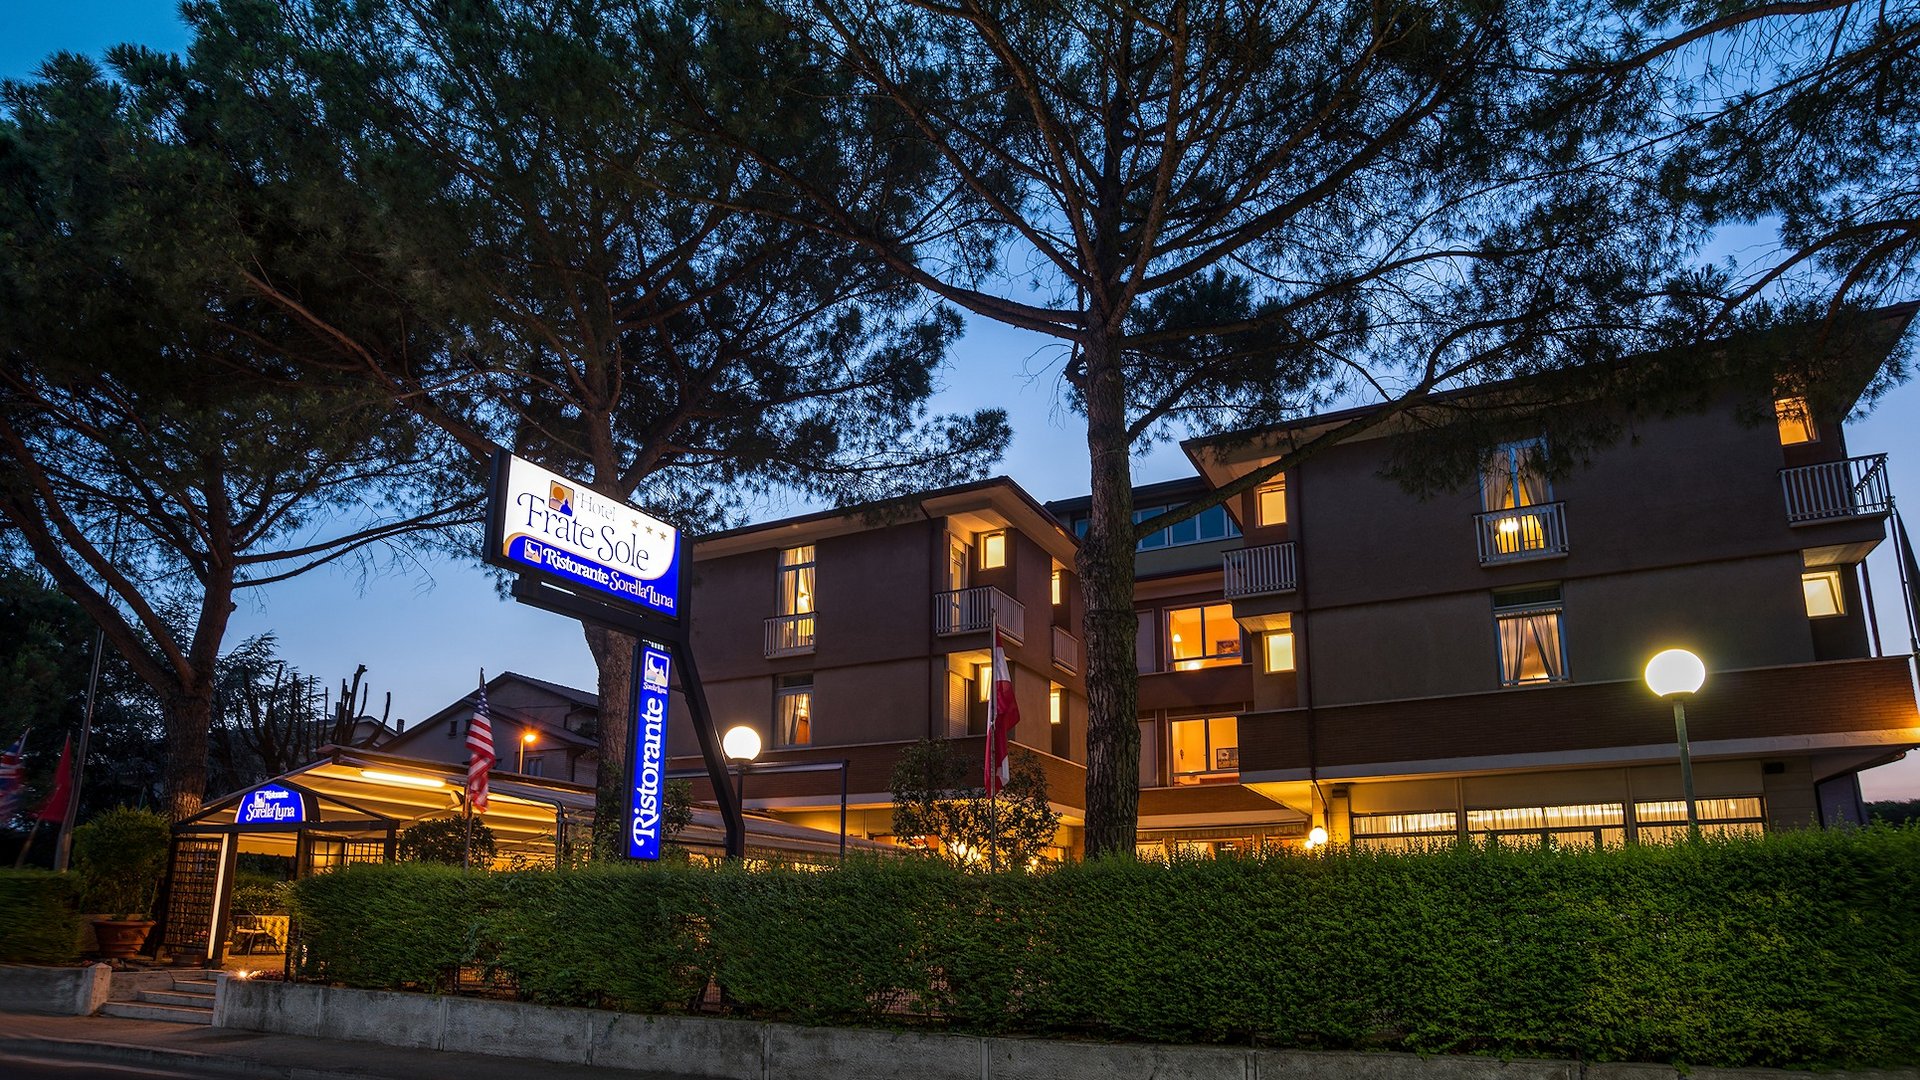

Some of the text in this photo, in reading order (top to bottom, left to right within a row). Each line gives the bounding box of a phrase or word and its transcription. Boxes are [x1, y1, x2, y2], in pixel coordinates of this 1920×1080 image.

[517, 492, 649, 571] Frate Sole
[576, 492, 616, 522] Hotel
[542, 548, 609, 585] Ristorante
[609, 571, 647, 599] Sorella
[632, 697, 664, 846] Ristorante
